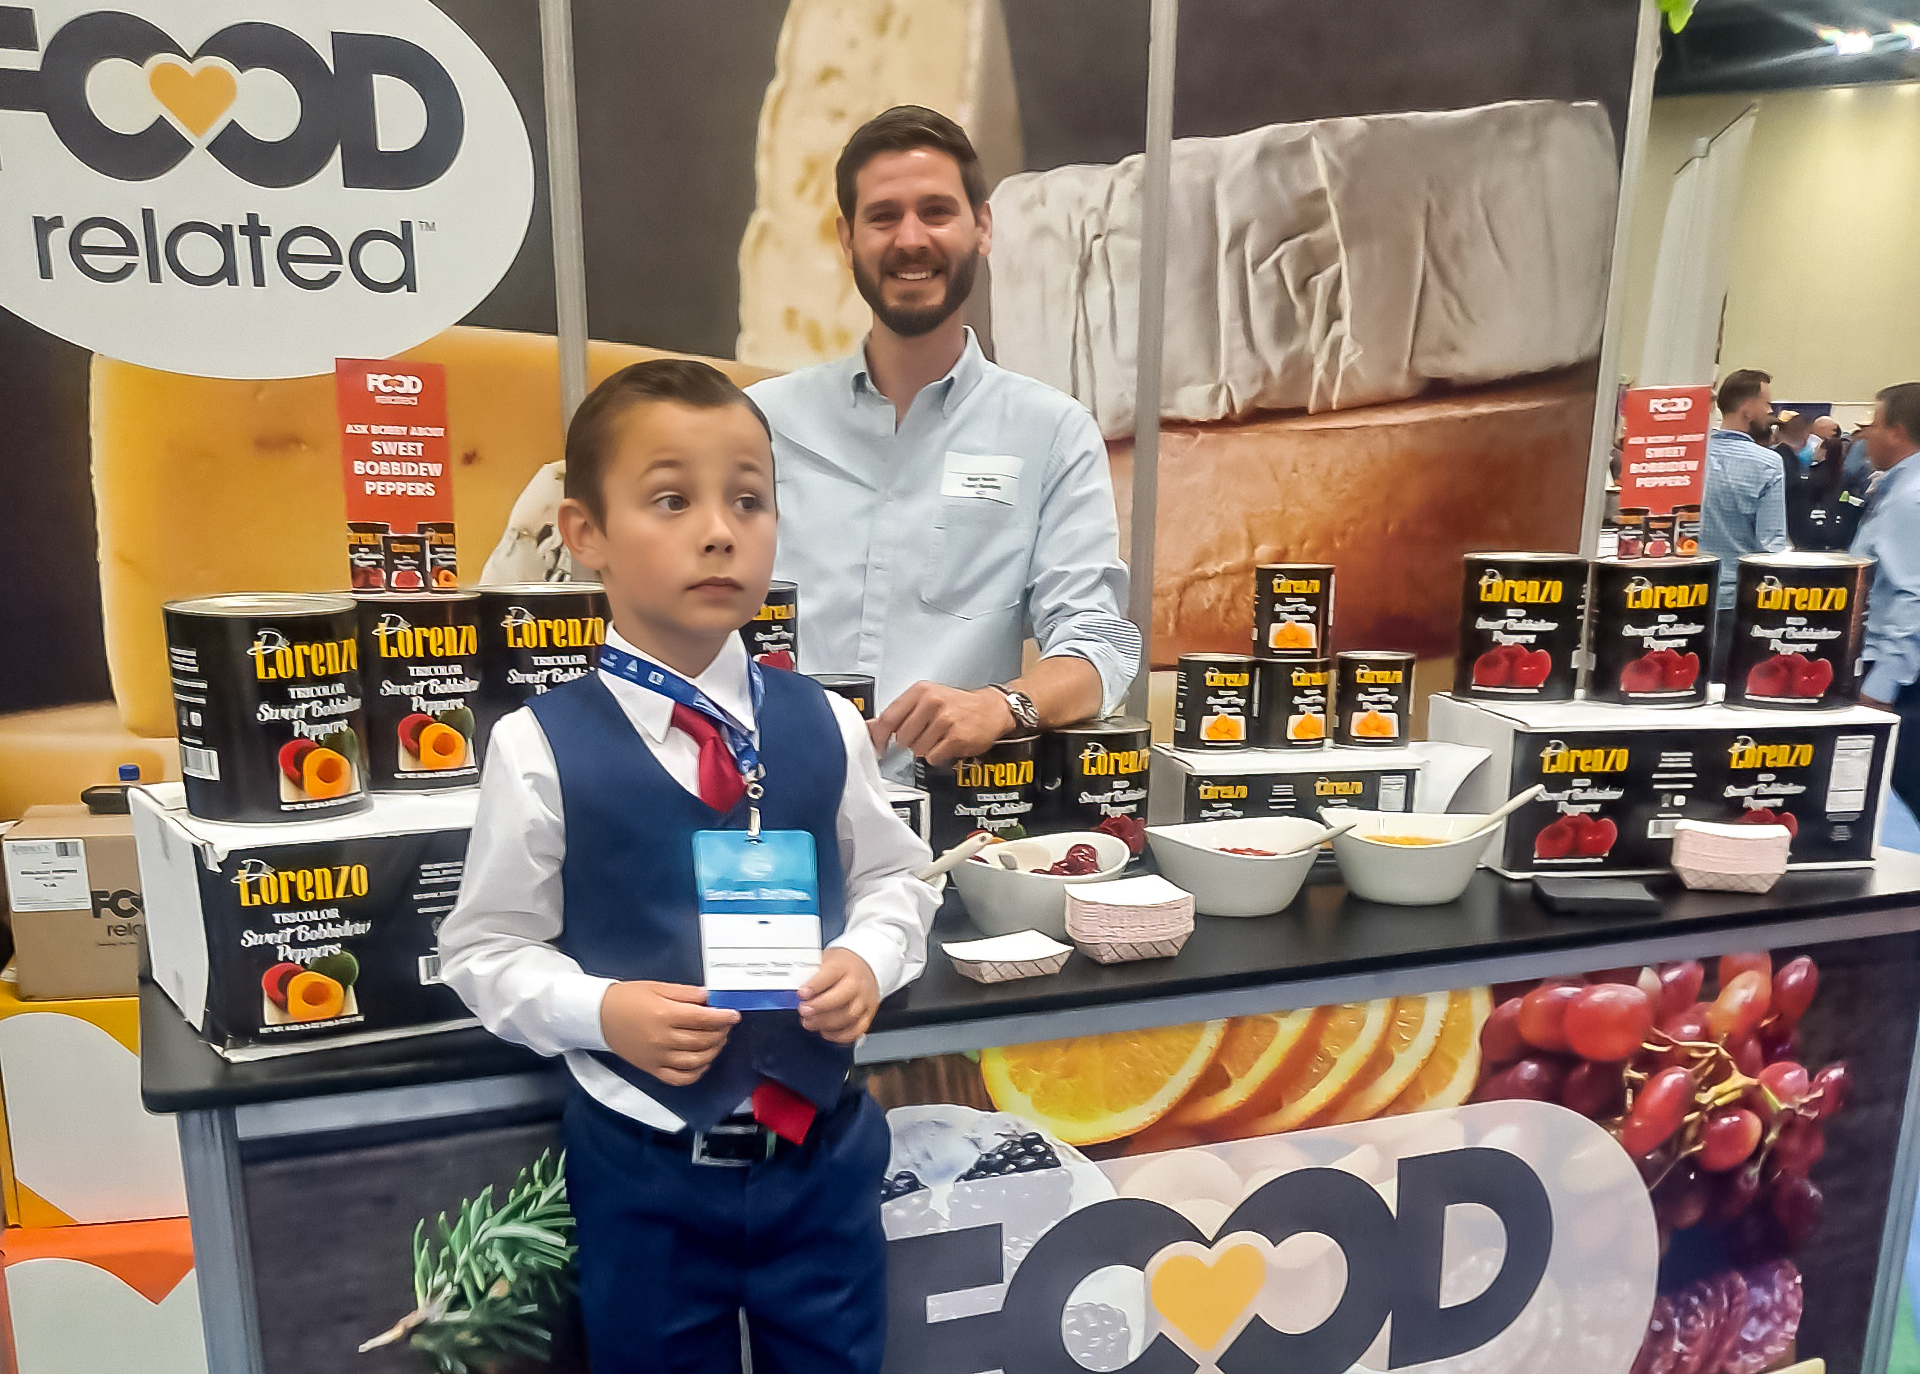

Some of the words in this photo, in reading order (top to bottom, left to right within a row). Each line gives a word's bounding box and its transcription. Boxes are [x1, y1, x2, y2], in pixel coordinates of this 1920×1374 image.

[32, 208, 418, 293] related
[366, 373, 423, 394] FOOD
[371, 441, 424, 457] SWEET
[353, 460, 443, 477] BOBBIDEW
[364, 481, 436, 496] PEPPERS
[378, 622, 478, 658] Lorenzo
[505, 614, 605, 648] Lorenzo
[238, 864, 369, 907] Lorenzo
